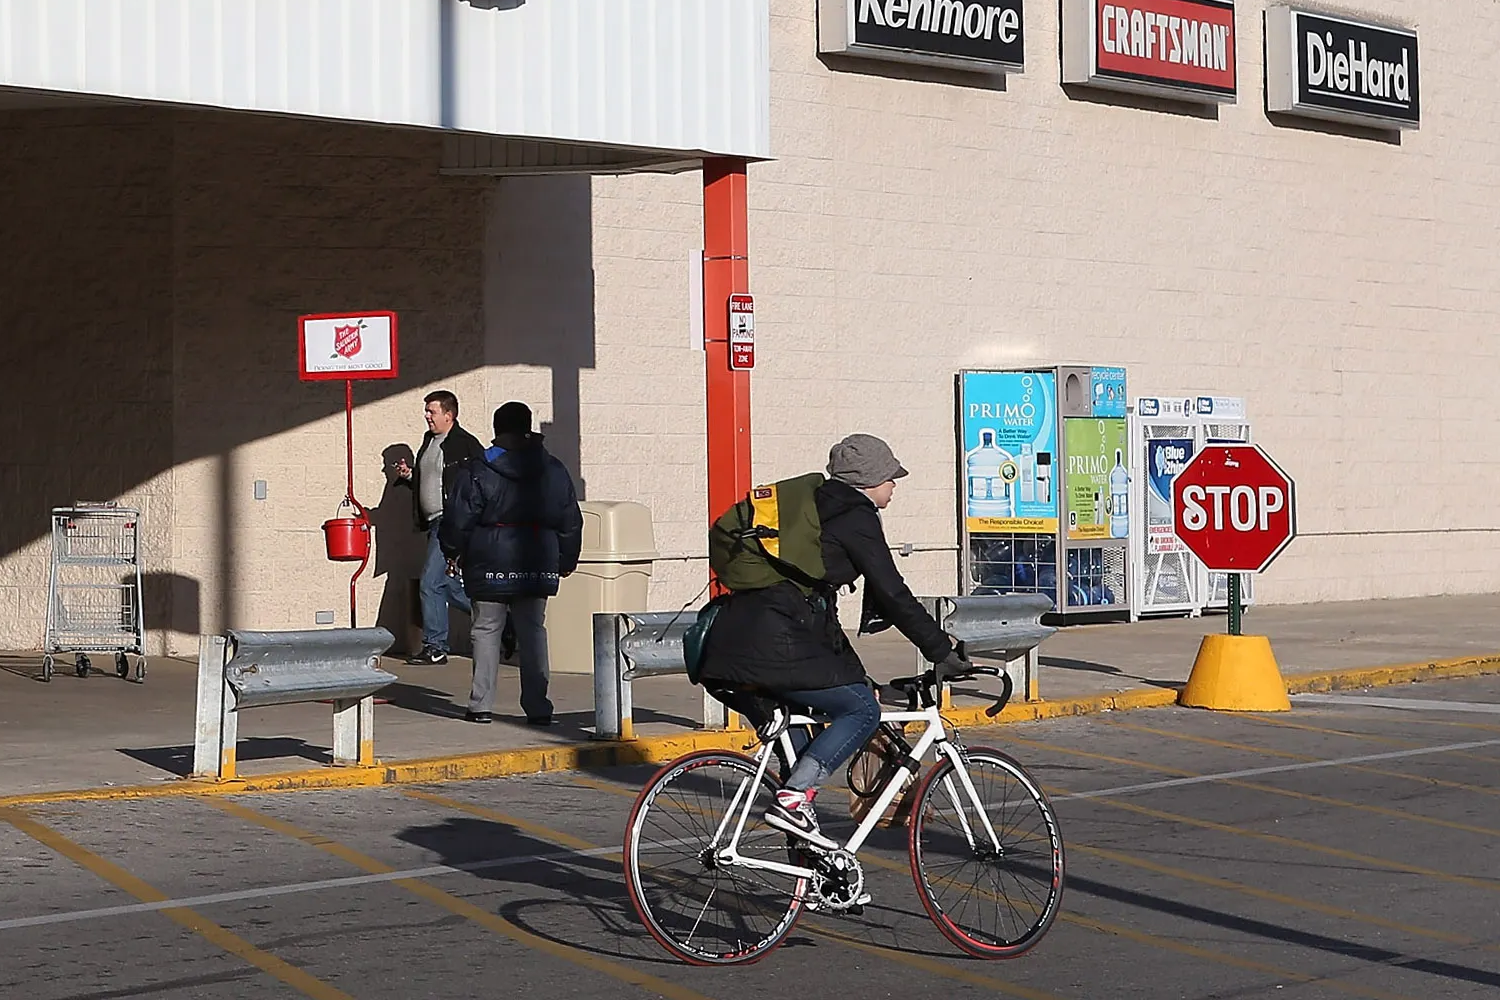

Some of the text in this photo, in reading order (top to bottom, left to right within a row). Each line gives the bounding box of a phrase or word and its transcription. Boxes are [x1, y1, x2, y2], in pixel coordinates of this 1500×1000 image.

[1101, 4, 1228, 72] CRAFTSMAN
[1305, 31, 1409, 102] DieHard
[969, 403, 1036, 418] PRIMO
[1003, 418, 1034, 426] WATER
[1165, 445, 1185, 460] Blue
[1069, 455, 1108, 474] PRIMO
[1182, 484, 1284, 531] STOP
